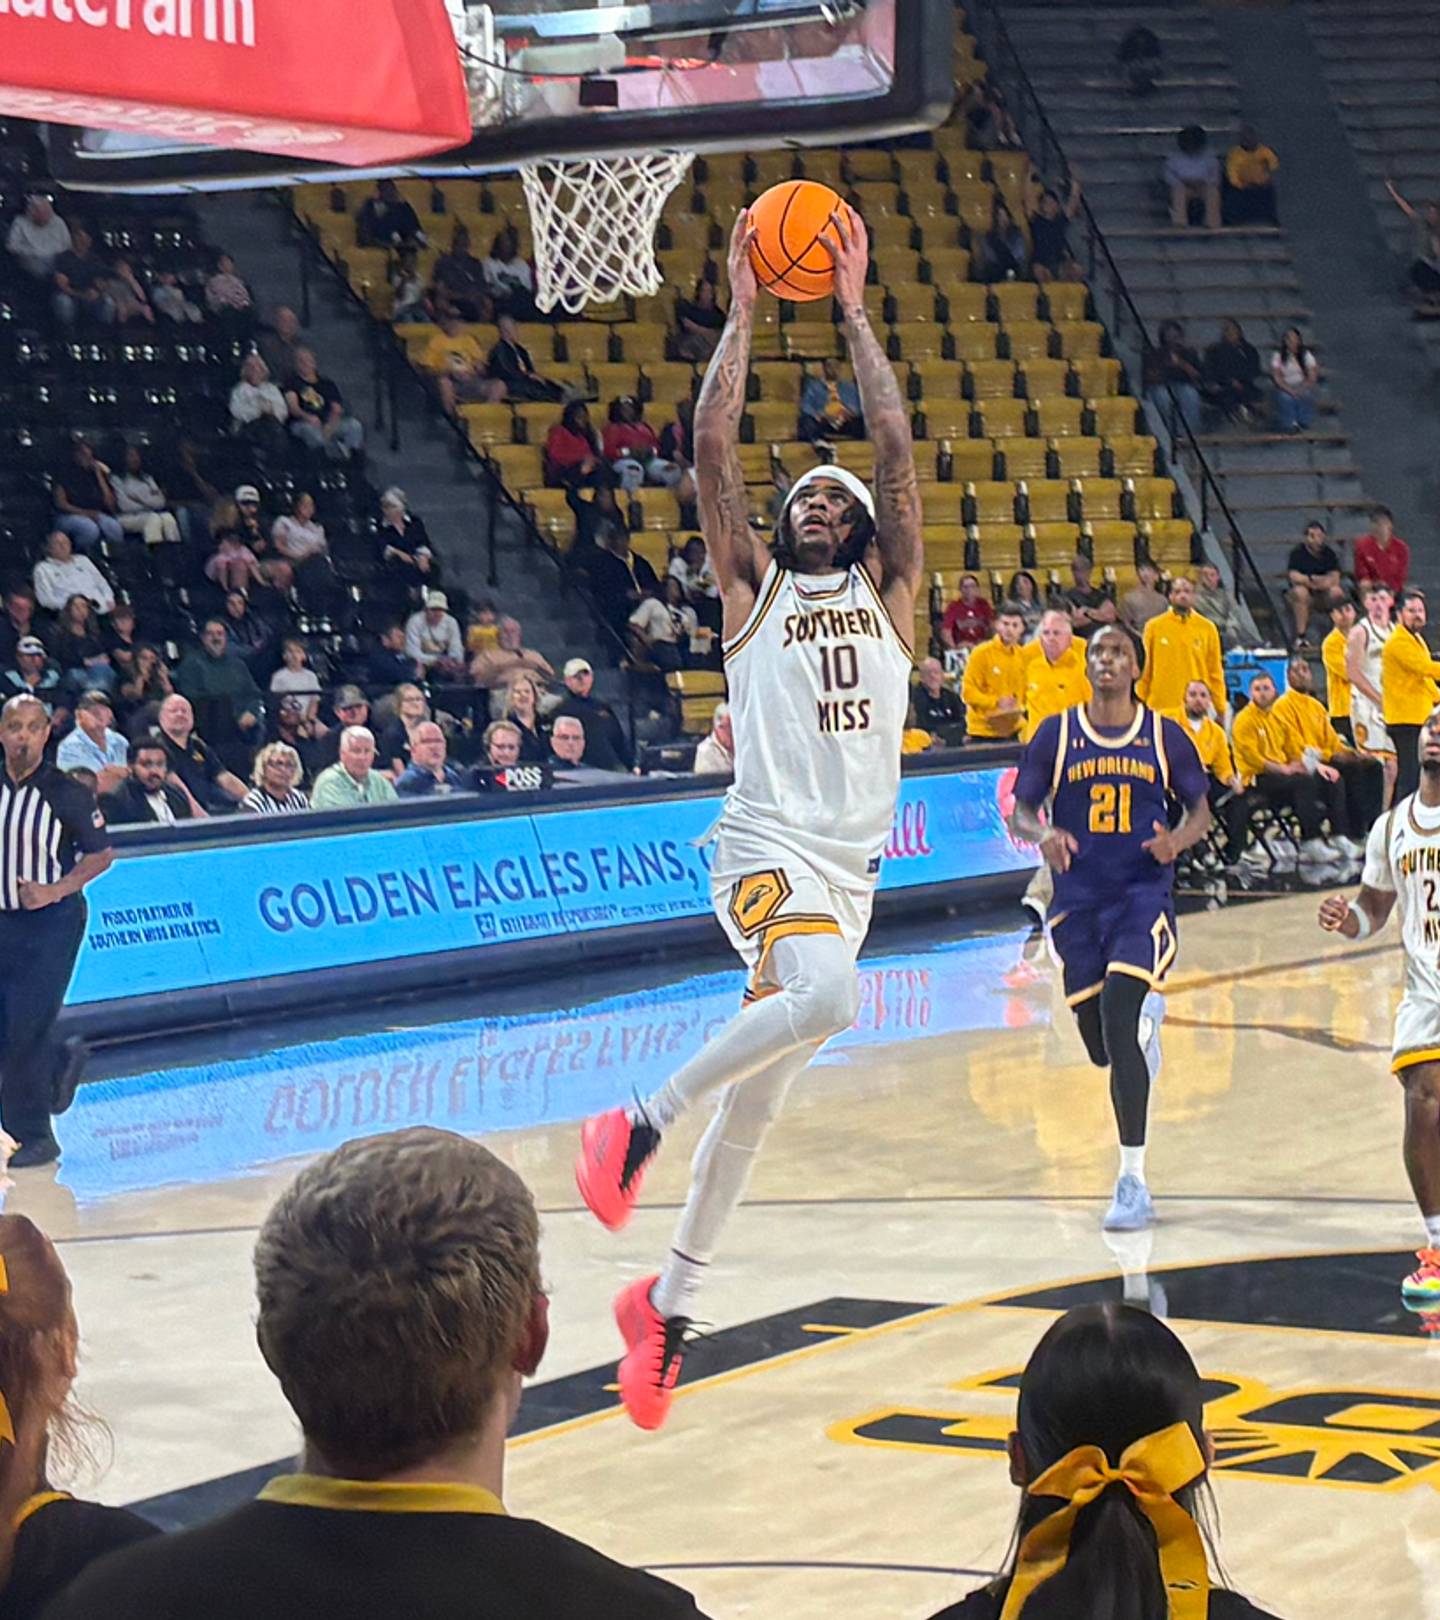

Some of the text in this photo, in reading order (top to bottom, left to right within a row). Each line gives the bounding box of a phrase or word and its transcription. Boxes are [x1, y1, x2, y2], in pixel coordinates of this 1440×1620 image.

[819, 645, 859, 692] 10
[817, 699, 871, 732] MISS
[1089, 783, 1131, 833] 21
[258, 867, 440, 933] GOLDEN
[442, 850, 588, 910] EAGLES
[591, 840, 699, 892] FANS,
[1423, 879, 1440, 912] 2
